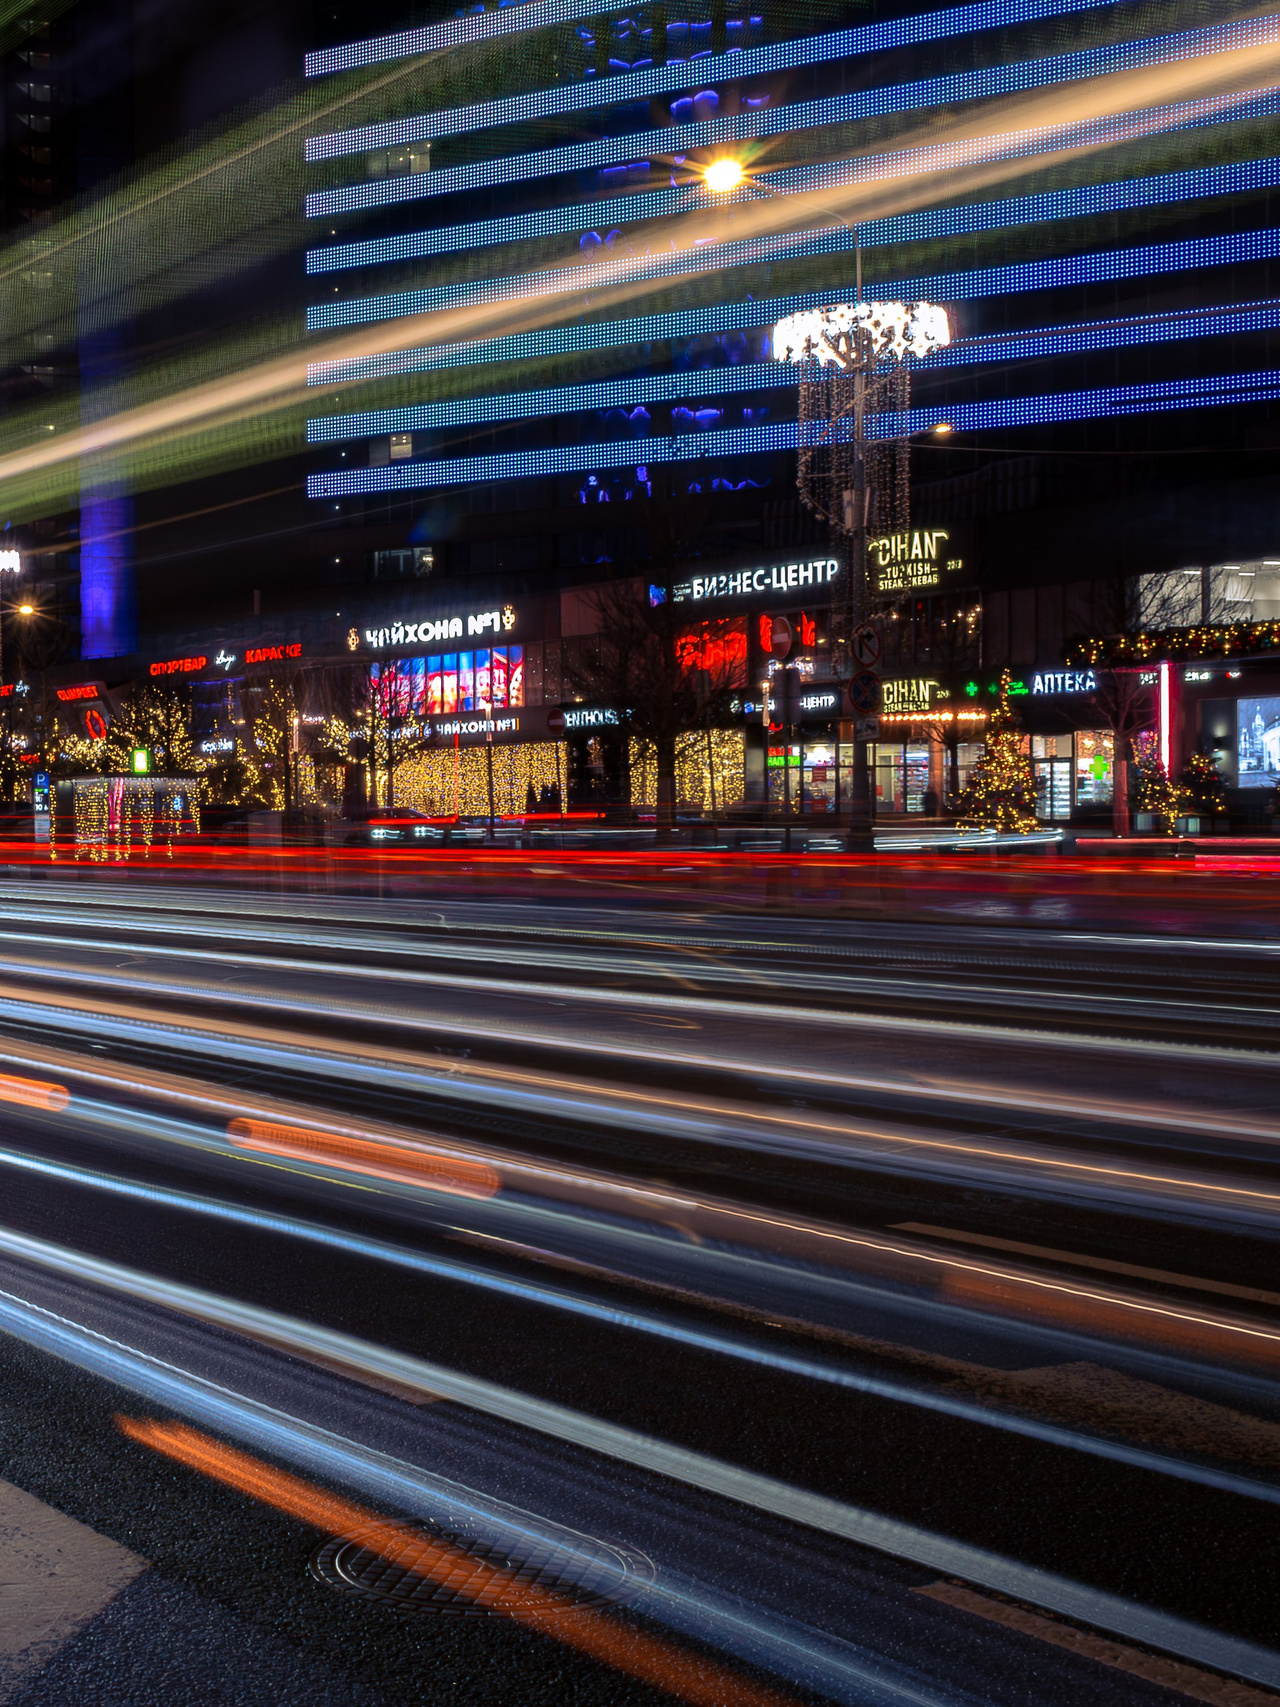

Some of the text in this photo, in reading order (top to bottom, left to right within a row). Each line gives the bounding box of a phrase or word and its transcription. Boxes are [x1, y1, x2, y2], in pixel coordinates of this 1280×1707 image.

[868, 532, 950, 566] CIHAN
[692, 559, 838, 600] БИЗНЕС-ЦЕНТР
[365, 611, 501, 648] ЧАЙХОНА №1
[882, 679, 940, 705] CIHAN
[1032, 671, 1097, 695] АПТЕКА
[435, 720, 495, 735] ЧАЙХОНА
